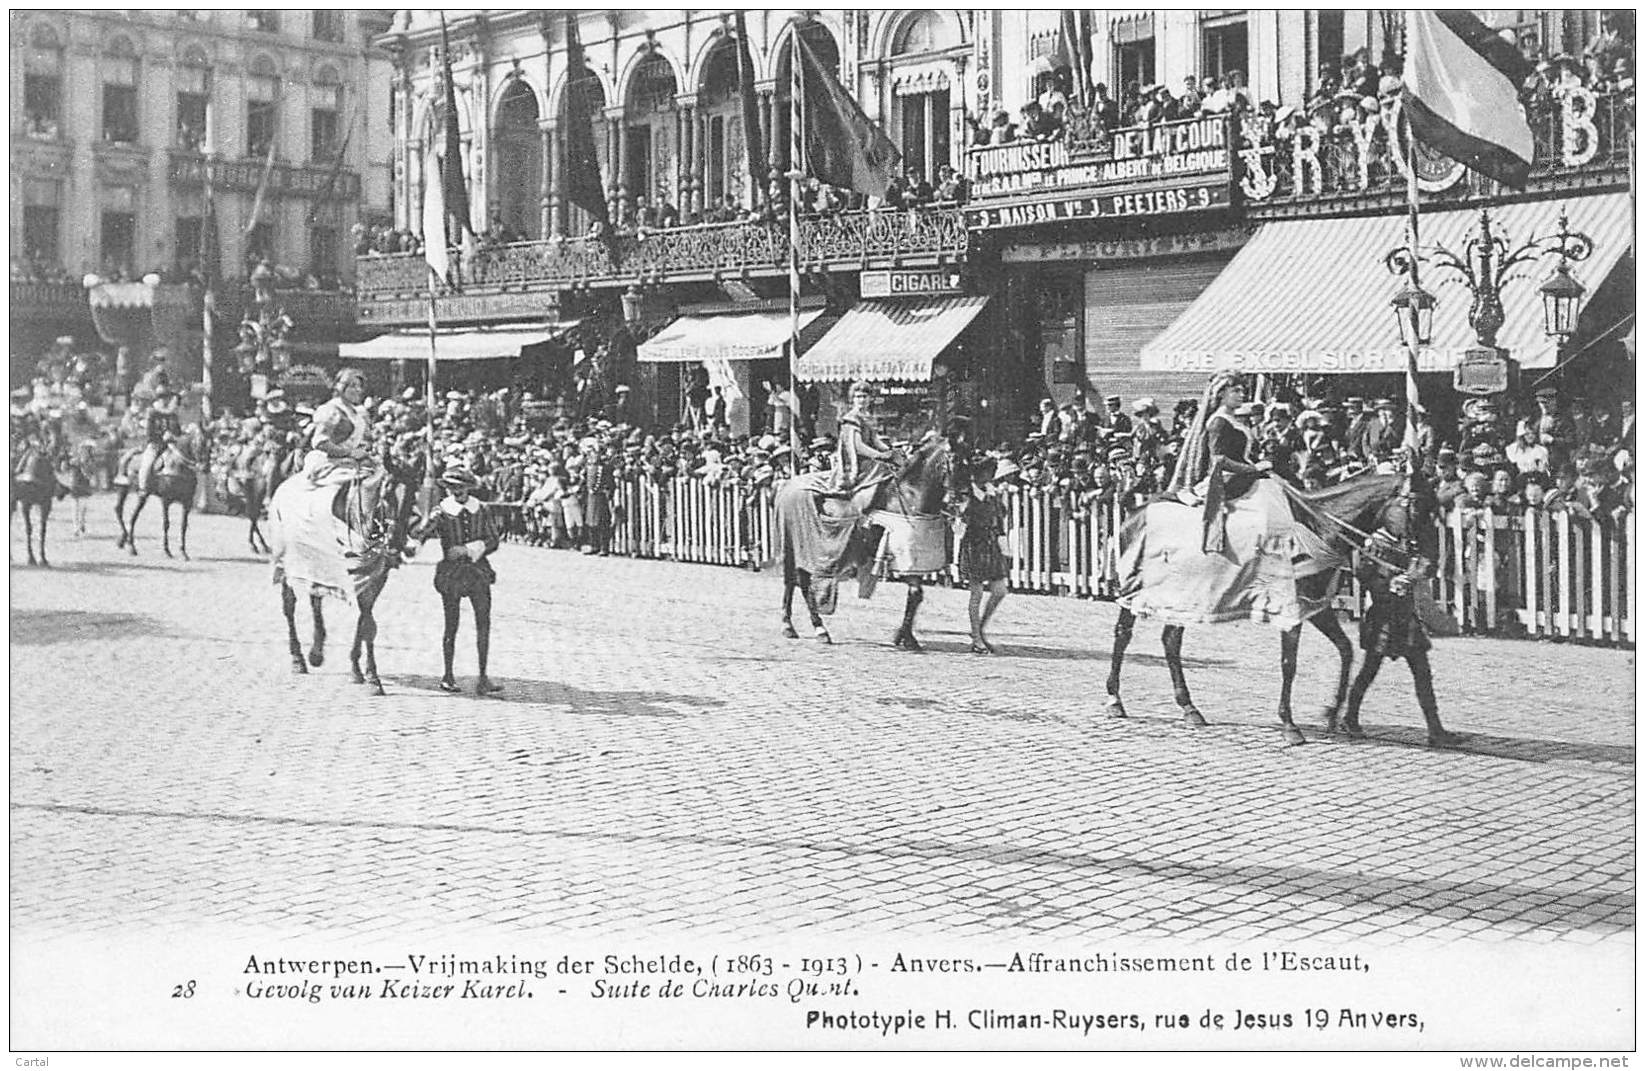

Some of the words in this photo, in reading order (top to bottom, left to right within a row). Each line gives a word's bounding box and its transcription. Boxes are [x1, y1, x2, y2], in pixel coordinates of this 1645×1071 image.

[1113, 131, 1137, 160] DE
[1176, 118, 1225, 153] COUR
[1056, 165, 1098, 186] PRINCE
[1103, 158, 1149, 181] ALBERT
[1164, 149, 1227, 173] BELGIQUE
[998, 203, 1056, 226] MAISON
[1113, 189, 1188, 217] PEETERS
[1230, 348, 1385, 370] EXCELSIOR
